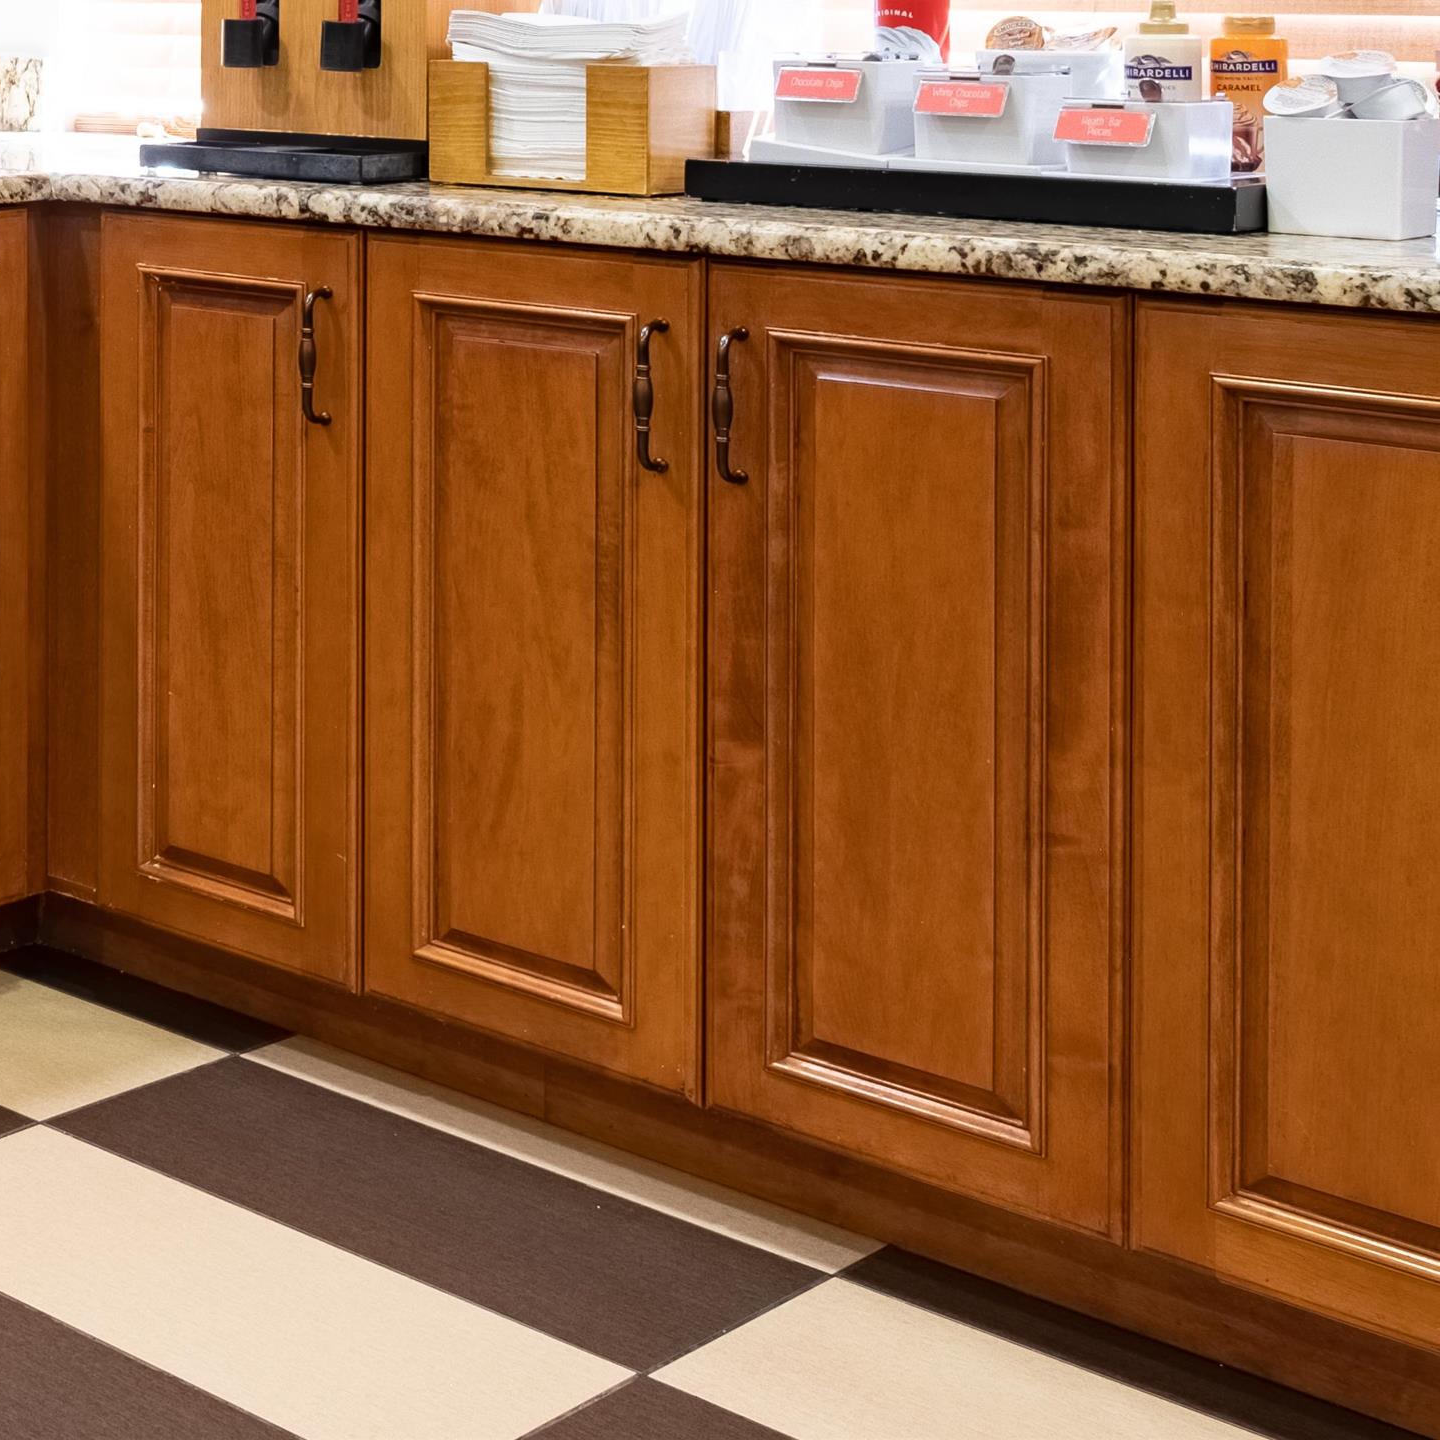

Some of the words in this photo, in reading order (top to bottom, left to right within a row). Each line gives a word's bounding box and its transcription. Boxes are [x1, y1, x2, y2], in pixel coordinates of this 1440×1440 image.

[1212, 62, 1276, 71] HIRARDELLI
[1125, 68, 1189, 78] HIRARDELLI
[1216, 84, 1262, 92] CARAMEL
